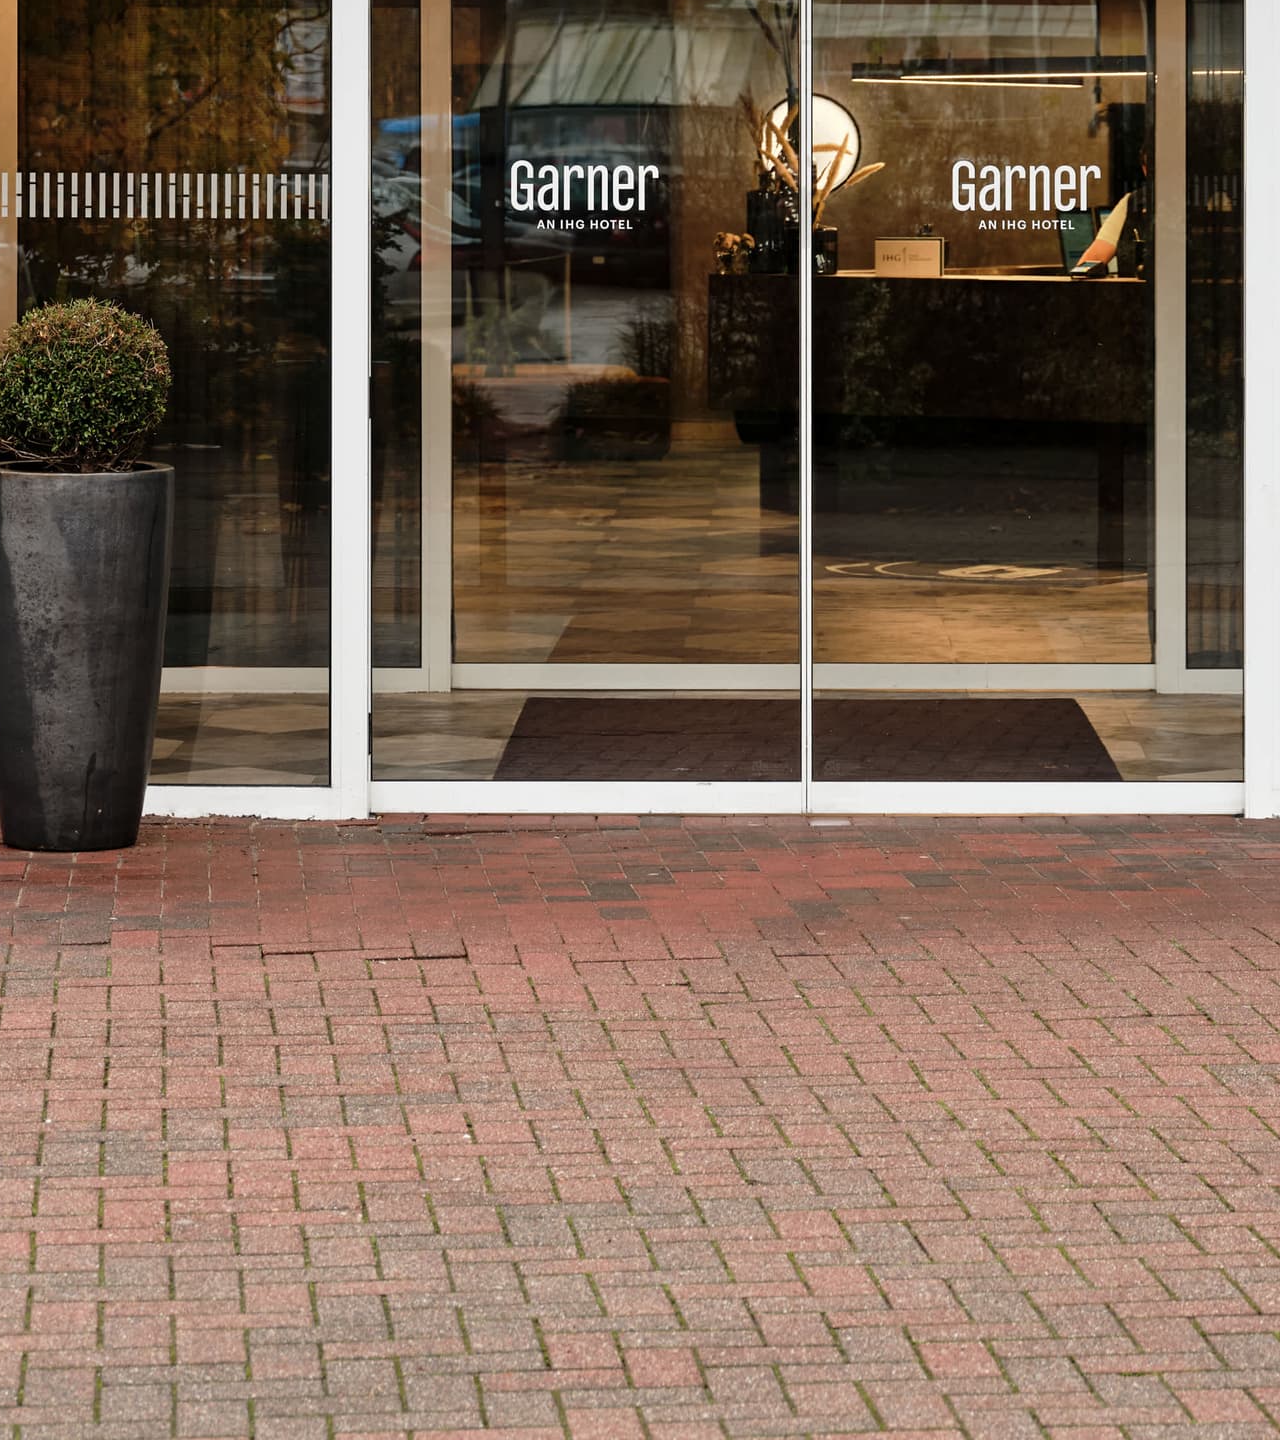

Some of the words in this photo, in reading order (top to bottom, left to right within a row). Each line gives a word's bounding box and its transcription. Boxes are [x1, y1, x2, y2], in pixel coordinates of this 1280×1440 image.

[510, 160, 659, 211] Garner
[952, 160, 1101, 212] Garner
[537, 219, 555, 230] AN
[560, 219, 585, 230] IHG
[590, 219, 633, 230] HOTEL
[978, 219, 997, 230] AN
[1002, 219, 1027, 230] IHG
[1032, 219, 1075, 230] HOTEL
